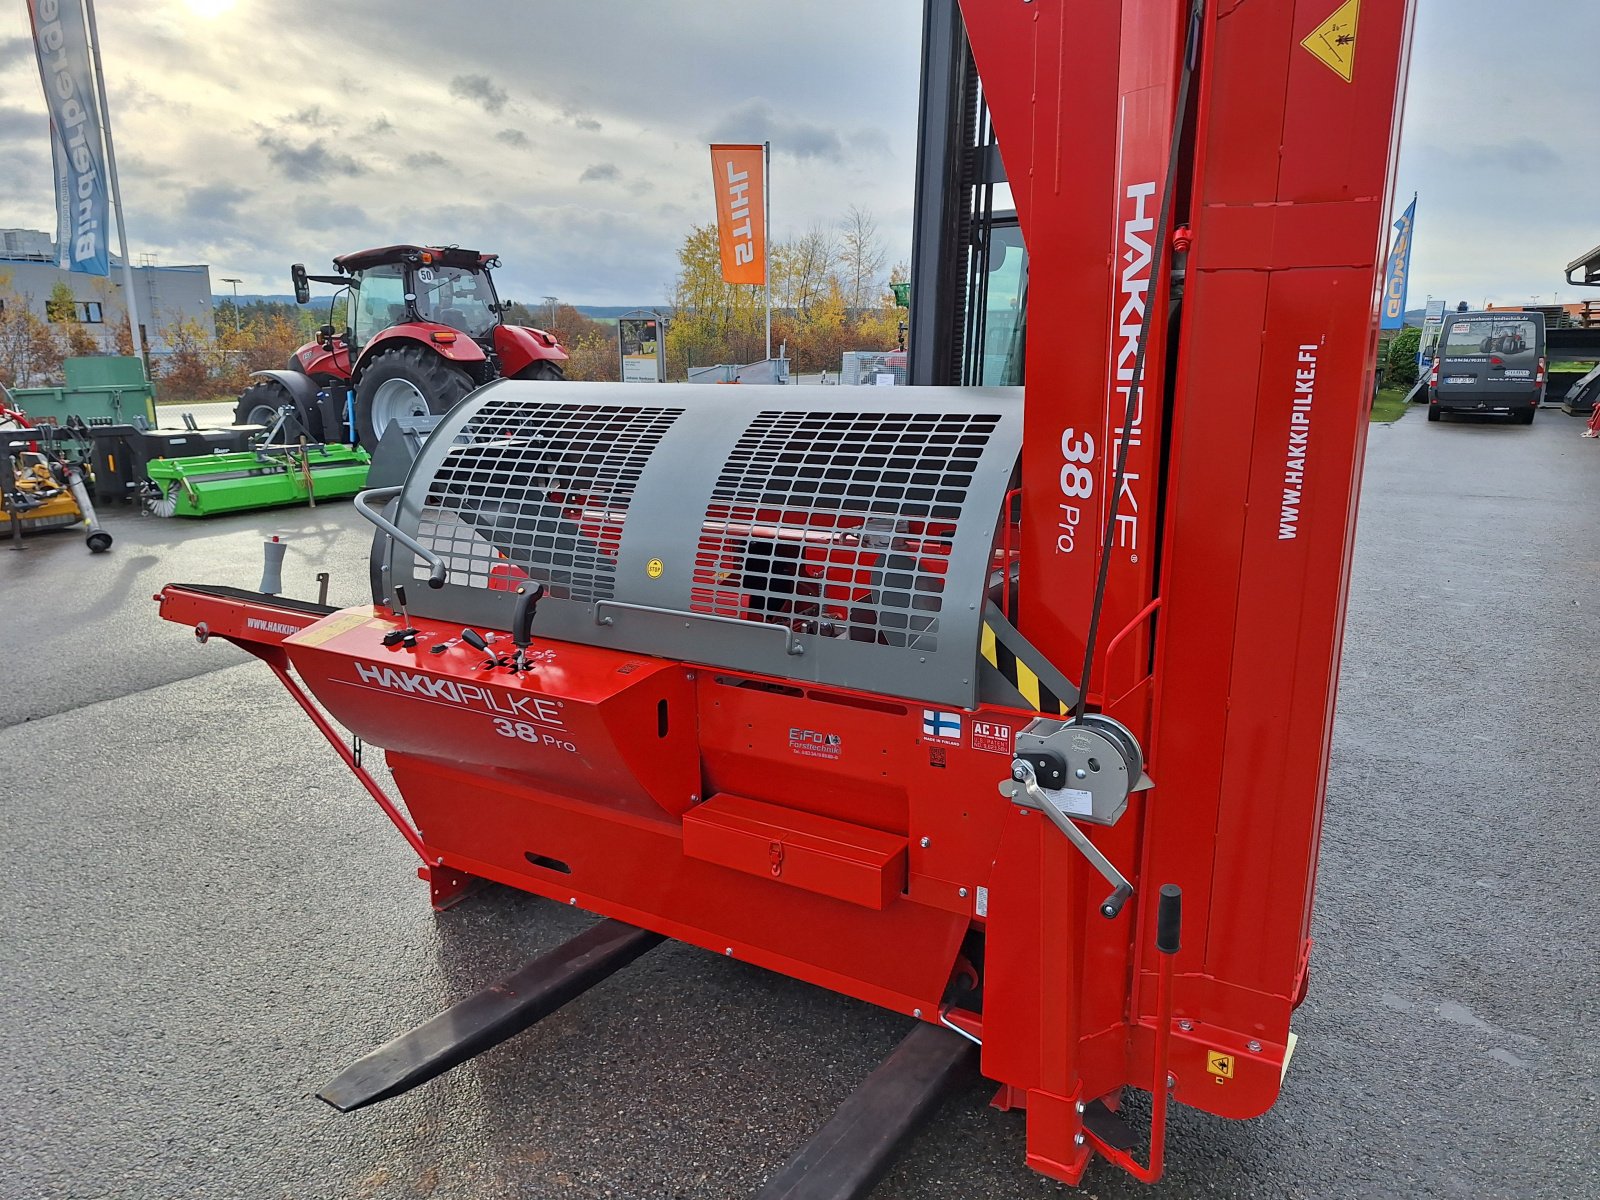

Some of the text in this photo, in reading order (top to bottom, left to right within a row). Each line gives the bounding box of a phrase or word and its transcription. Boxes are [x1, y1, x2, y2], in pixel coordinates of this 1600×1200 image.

[420, 270, 432, 280] 50
[1278, 344, 1318, 540] WWW.HAKKIPILKE.FI
[1057, 428, 1095, 553] 38 Pro
[354, 660, 563, 724] HAKKIPILKE
[493, 718, 576, 752] 38 Pro
[789, 740, 841, 754] Forsttechnik
[974, 723, 989, 735] AC
[994, 726, 1008, 738] 10
